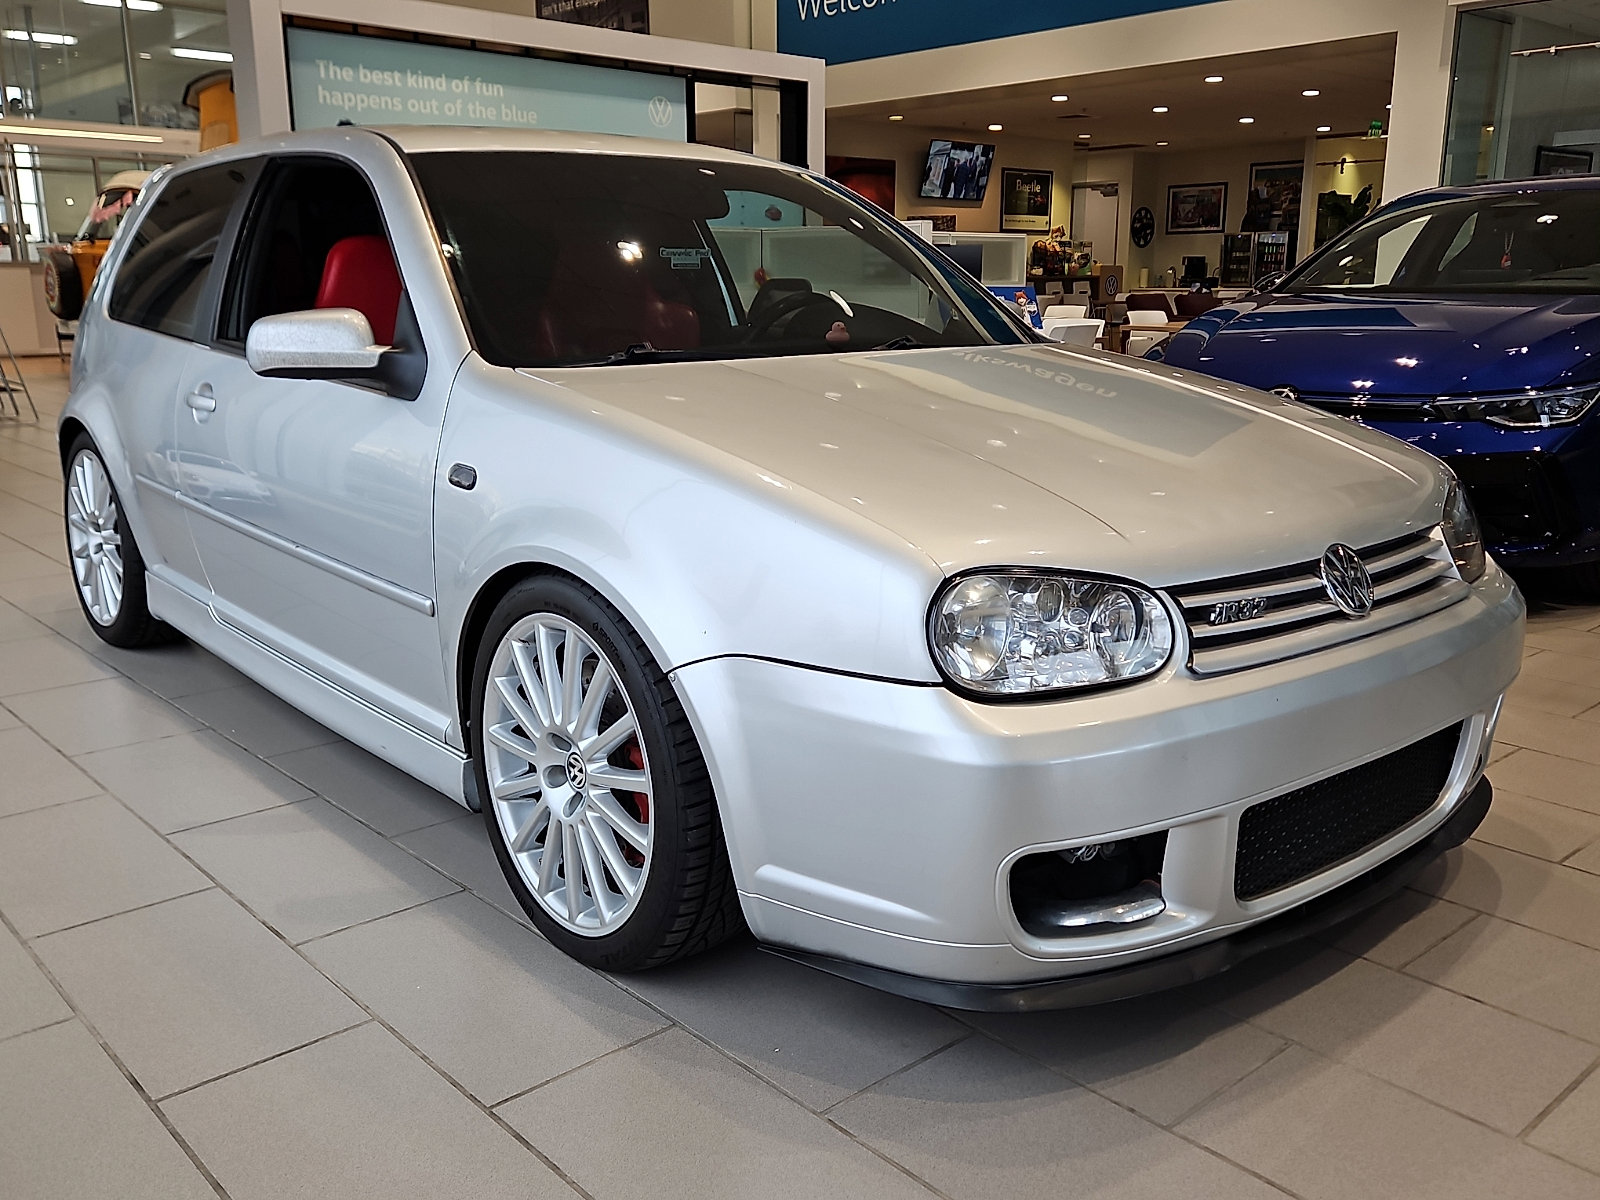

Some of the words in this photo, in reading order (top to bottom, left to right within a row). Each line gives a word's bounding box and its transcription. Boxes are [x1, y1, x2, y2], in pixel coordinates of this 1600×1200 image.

[316, 59, 354, 82] The
[359, 63, 402, 88] best
[407, 69, 446, 92] kind
[452, 76, 470, 94] of
[475, 77, 504, 97] fun
[317, 84, 403, 112] happens
[407, 99, 439, 115] out
[444, 100, 462, 117] of
[467, 101, 497, 120] the
[501, 103, 538, 124] blue
[1016, 178, 1041, 193] Beetle
